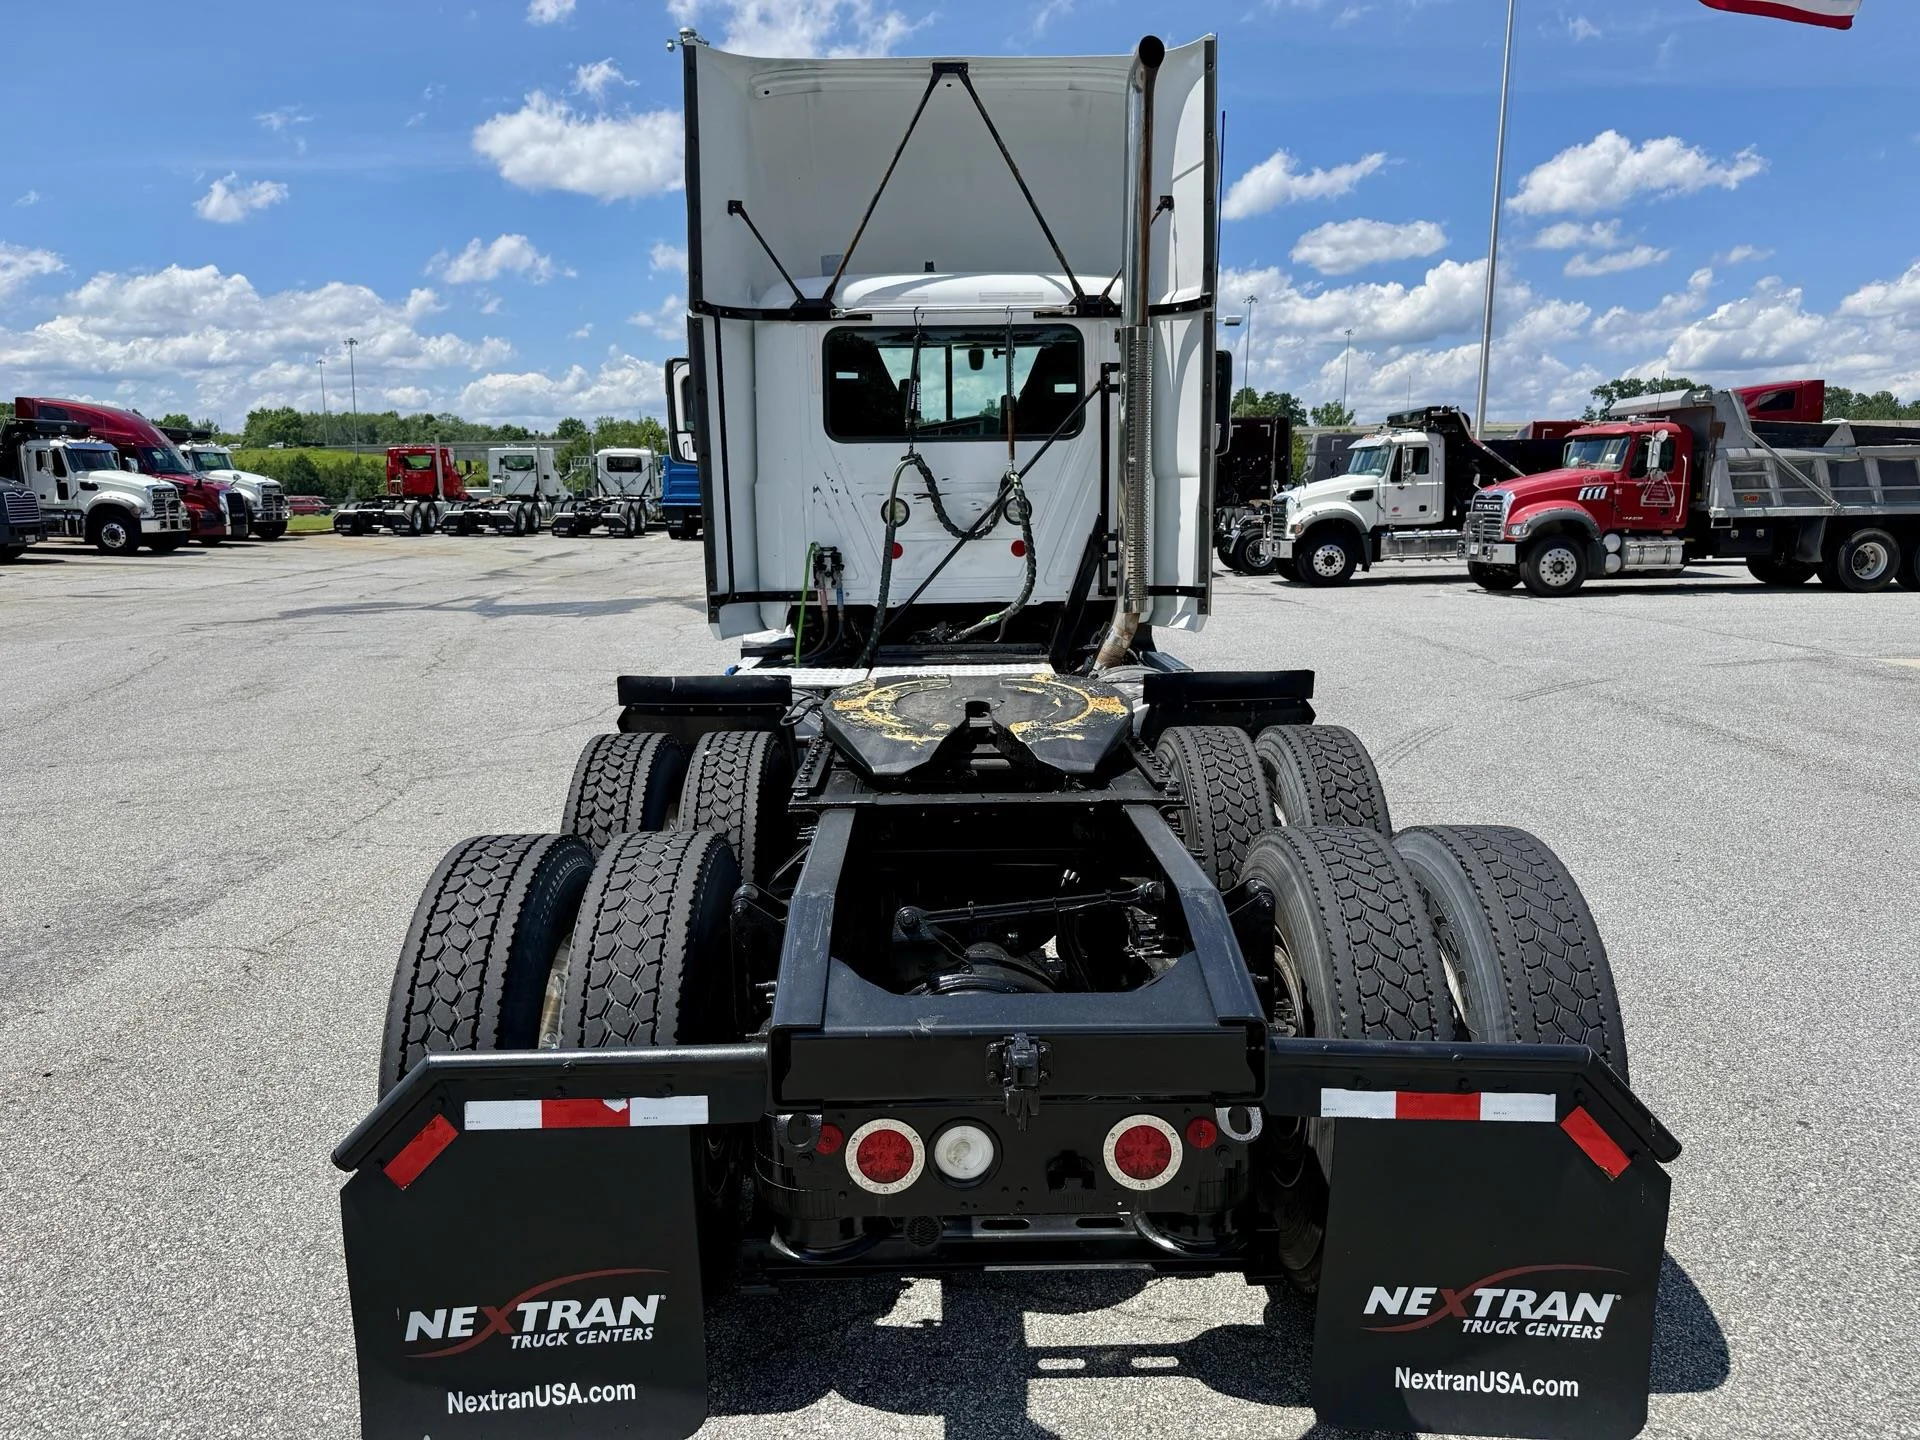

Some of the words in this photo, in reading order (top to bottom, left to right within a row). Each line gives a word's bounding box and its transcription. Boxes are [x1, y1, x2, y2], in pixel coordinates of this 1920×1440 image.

[1475, 503, 1501, 511] MACK
[510, 1334, 569, 1350] TRUCK
[575, 1326, 654, 1345] CENTERS
[1462, 1319, 1518, 1335] TRUCK
[1525, 1322, 1604, 1340] CENTERS
[1395, 1366, 1579, 1397] NextranUSA.com
[447, 1382, 636, 1414] NextranUSA.com
